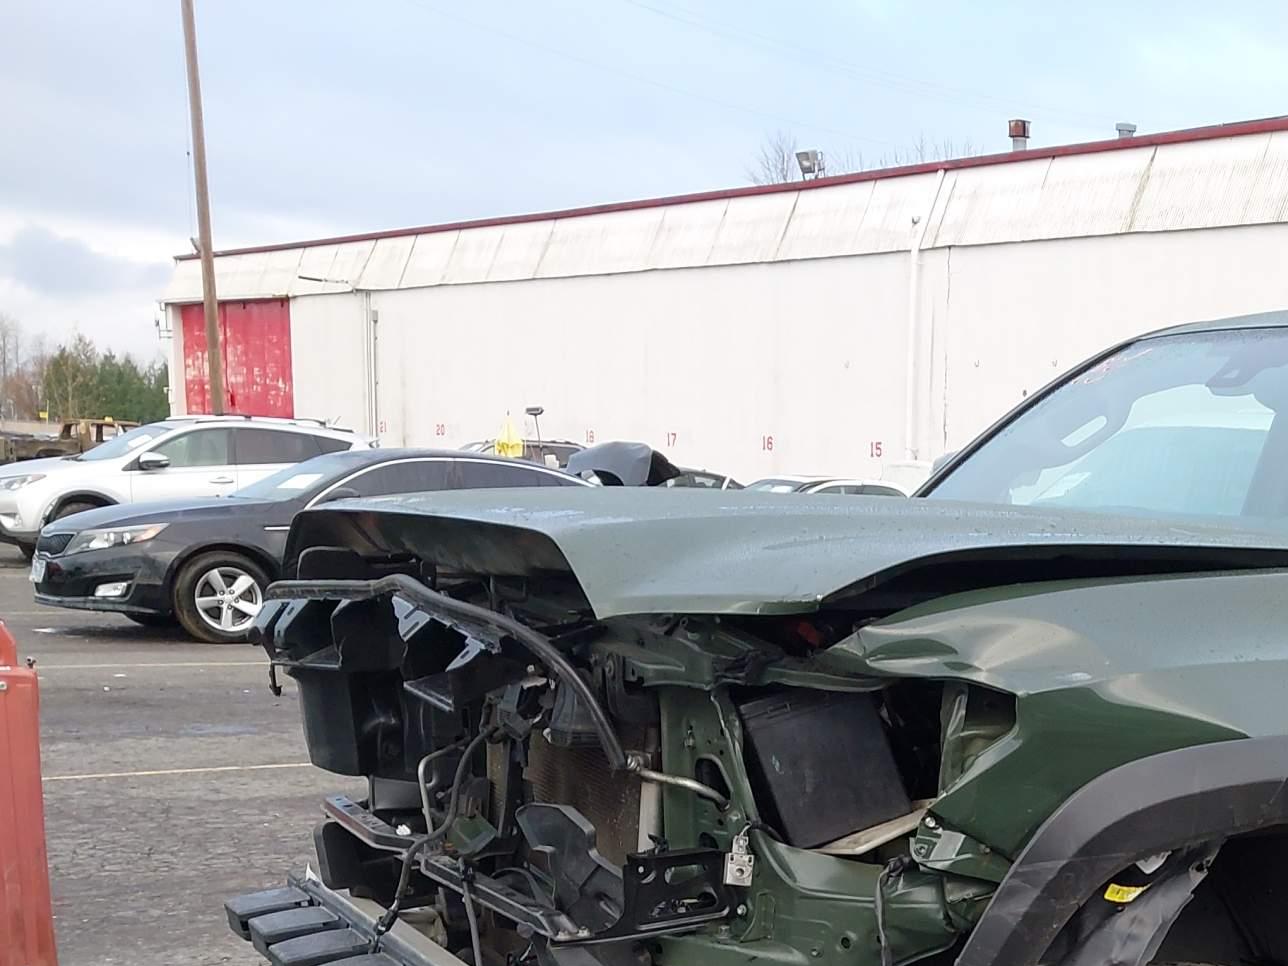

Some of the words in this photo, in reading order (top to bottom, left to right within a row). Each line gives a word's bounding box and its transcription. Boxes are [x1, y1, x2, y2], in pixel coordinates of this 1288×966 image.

[436, 424, 446, 436] 20
[667, 433, 677, 447] 17
[762, 436, 774, 450] 16
[870, 442, 883, 458] 15
